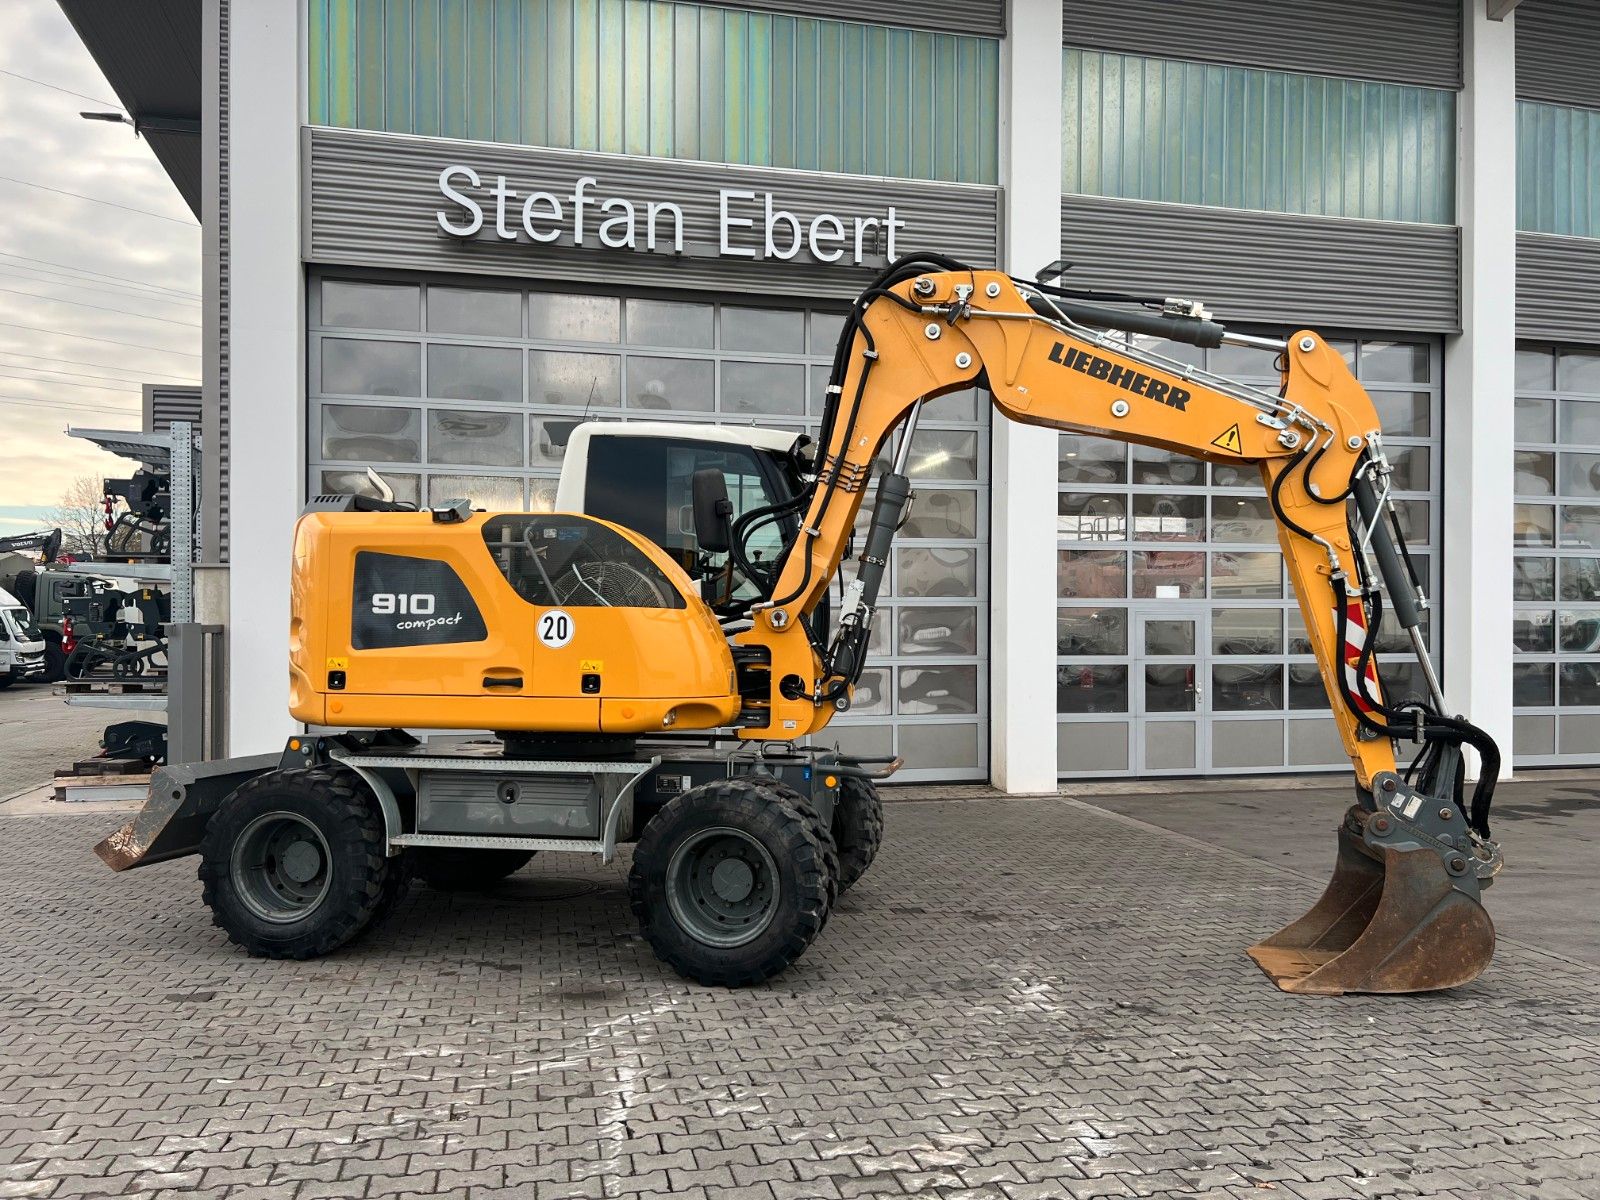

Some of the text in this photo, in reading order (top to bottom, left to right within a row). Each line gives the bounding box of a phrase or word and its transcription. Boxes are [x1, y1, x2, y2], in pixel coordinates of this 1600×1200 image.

[436, 165, 906, 265] Stefan Ebert
[1048, 341, 1191, 412] LIEBHERR
[372, 593, 435, 614] 910
[396, 612, 462, 630] compact
[543, 616, 567, 640] 20
